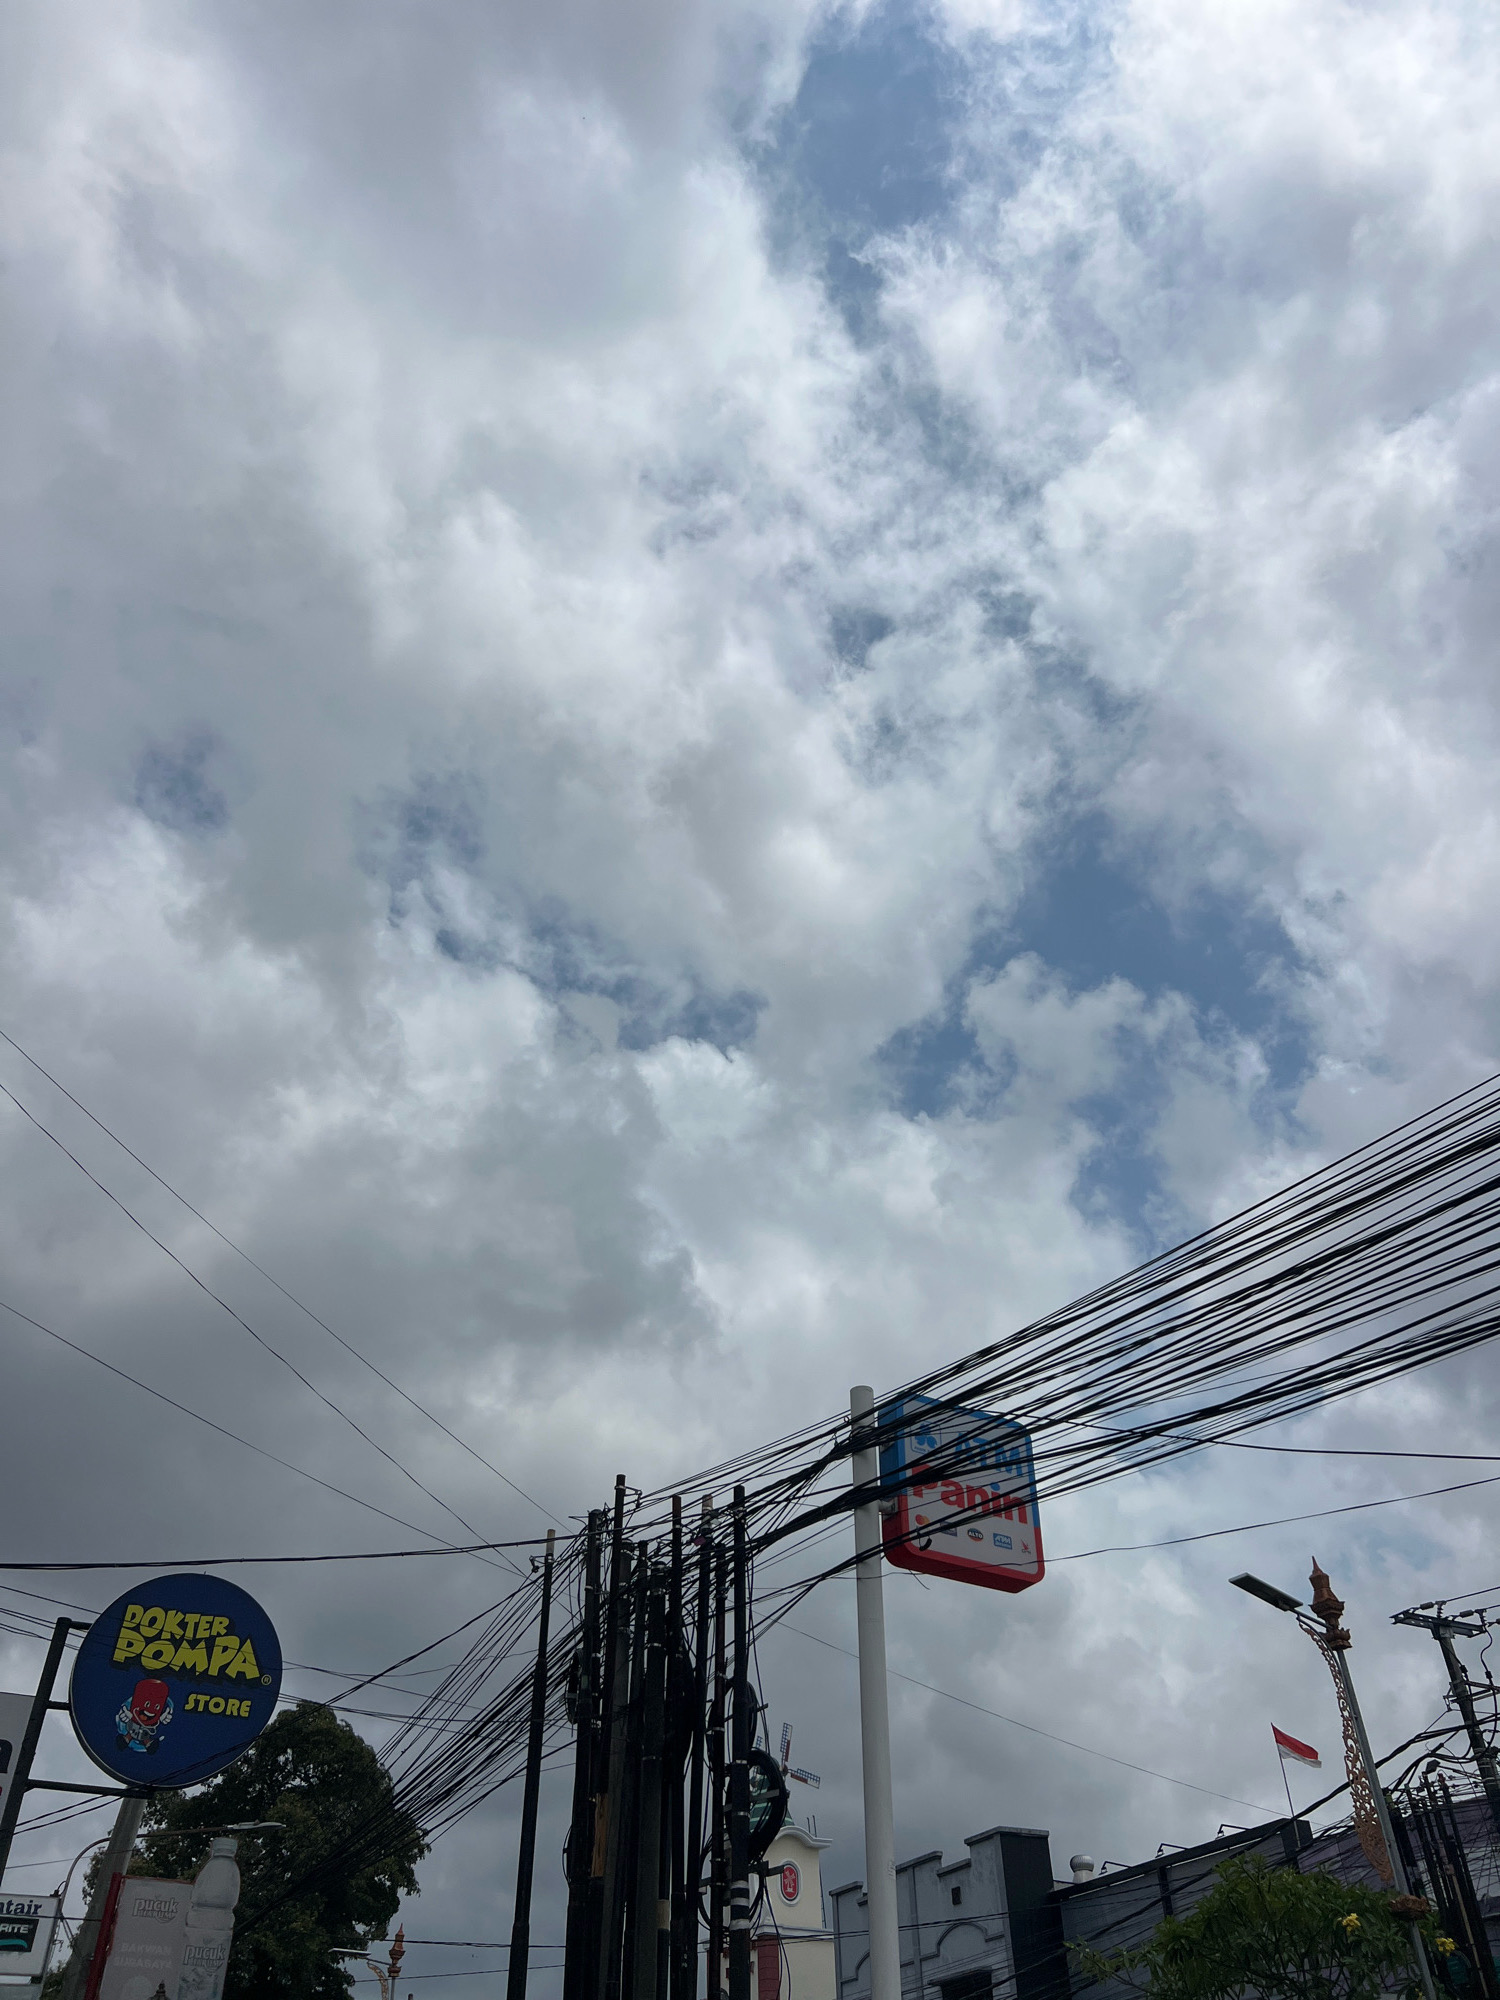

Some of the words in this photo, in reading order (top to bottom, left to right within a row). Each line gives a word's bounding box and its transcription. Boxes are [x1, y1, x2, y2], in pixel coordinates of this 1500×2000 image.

[123, 1604, 230, 1640] DOKTER
[112, 1627, 261, 1680] POMPA
[184, 1693, 252, 1718] STORE
[133, 1898, 178, 1917] pucuk
[183, 1944, 225, 1966] pucuk
